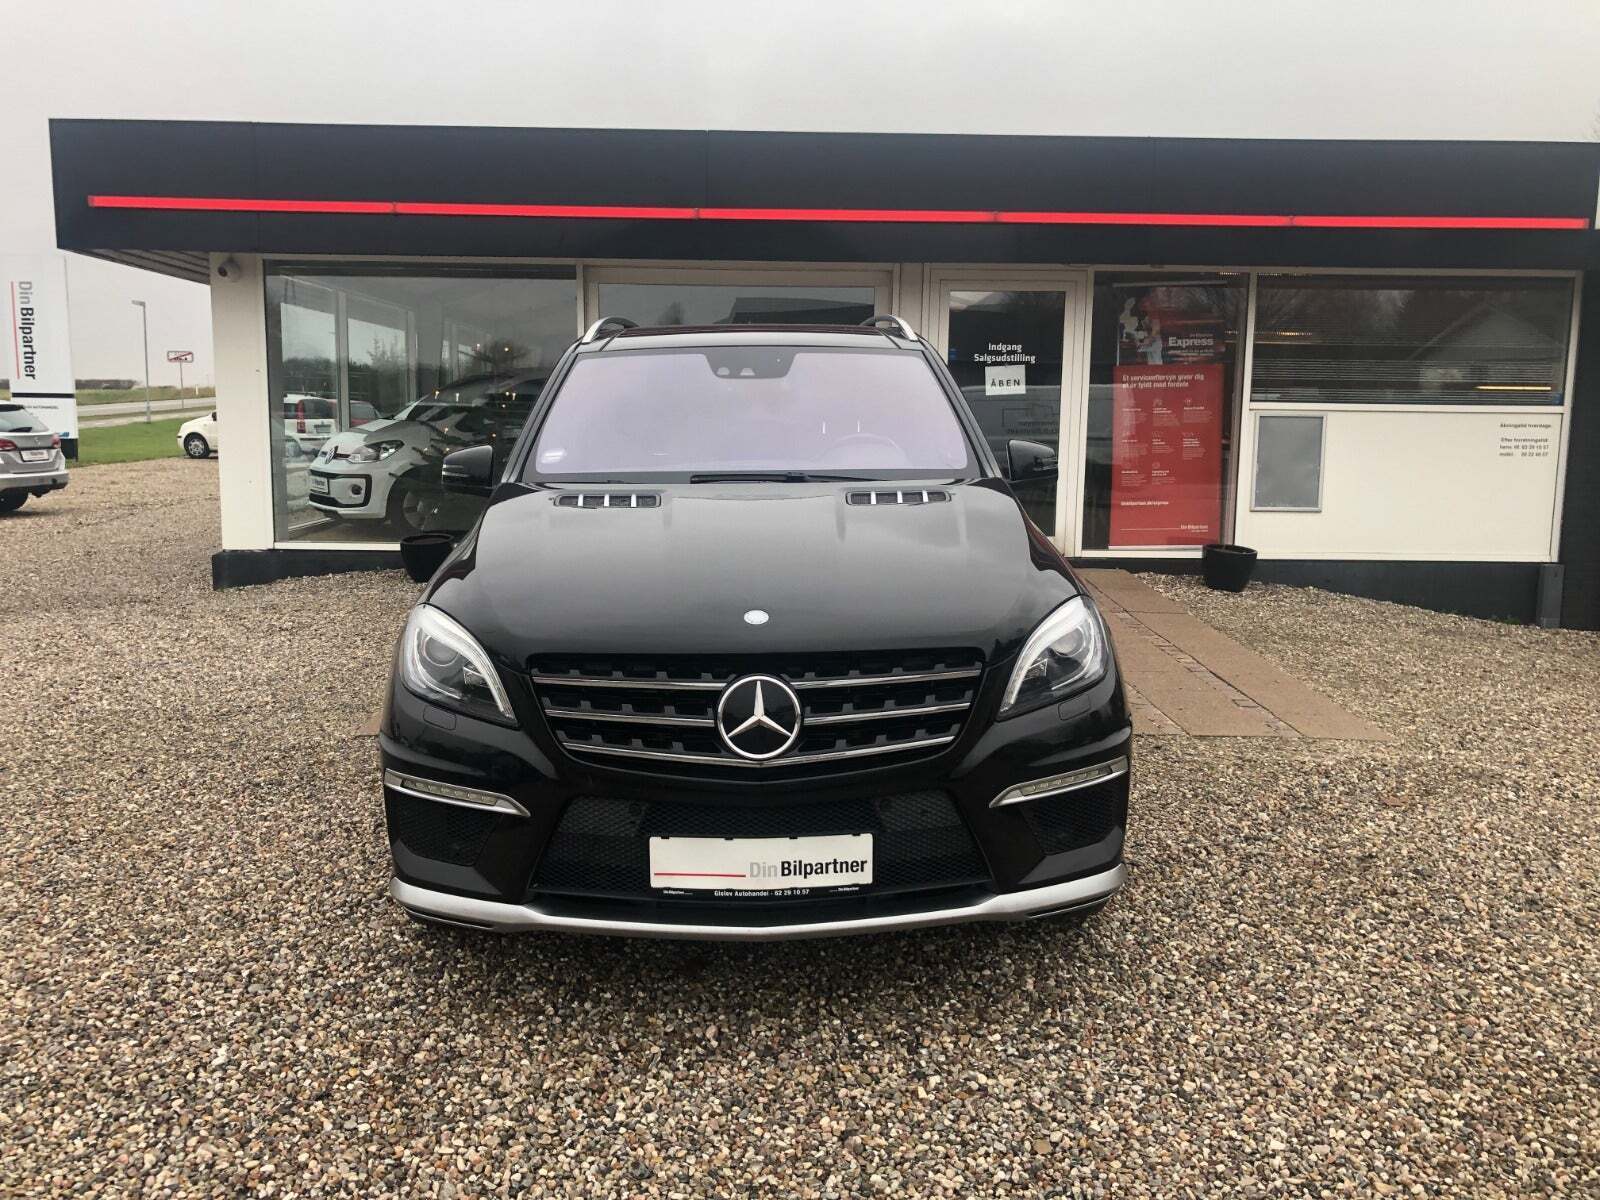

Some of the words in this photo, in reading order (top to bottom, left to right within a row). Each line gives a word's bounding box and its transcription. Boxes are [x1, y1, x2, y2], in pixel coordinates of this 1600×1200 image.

[19, 281, 33, 304] Din
[19, 307, 36, 380] Bilpartner
[988, 342, 1022, 353] Indgang
[1168, 336, 1214, 348] Express
[974, 353, 1036, 364] Salgsudstilling
[750, 861, 778, 878] Din
[780, 858, 868, 879] Bilpartner
